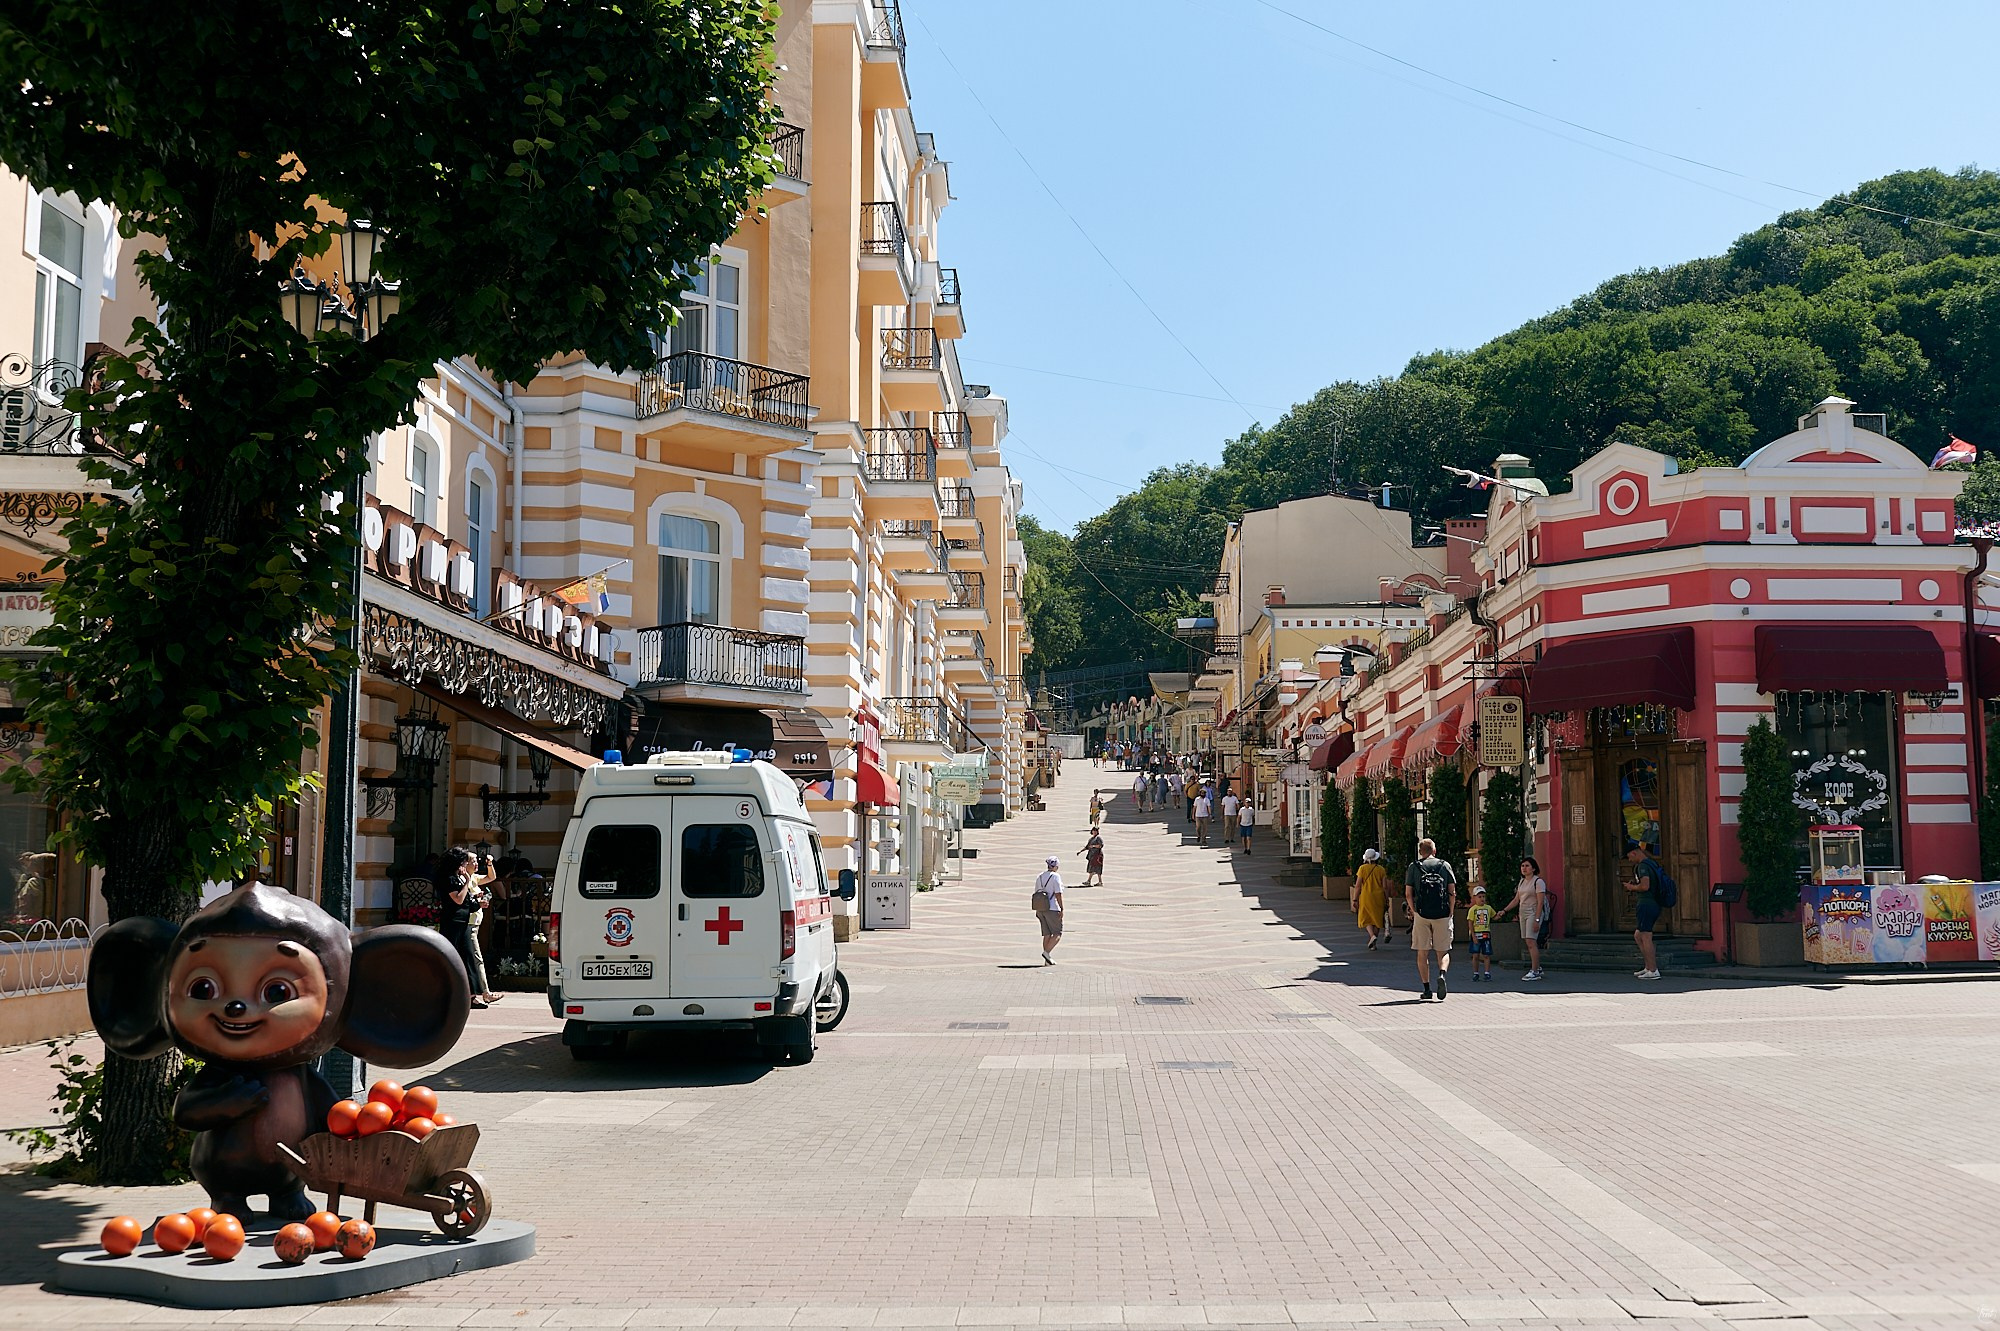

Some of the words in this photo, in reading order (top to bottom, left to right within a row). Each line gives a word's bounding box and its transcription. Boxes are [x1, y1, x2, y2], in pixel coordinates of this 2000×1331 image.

[0, 595, 45, 611] АТО
[1824, 782, 1854, 798] КОФЕ
[740, 803, 749, 816] 5
[1980, 890, 2000, 902] МЯГ
[1824, 900, 1869, 912] ПОПКОРН
[1978, 898, 2000, 910] МОРО
[1930, 921, 1970, 932] ВАРЕНАЯ
[1927, 930, 1975, 942] КУКУРУЗА
